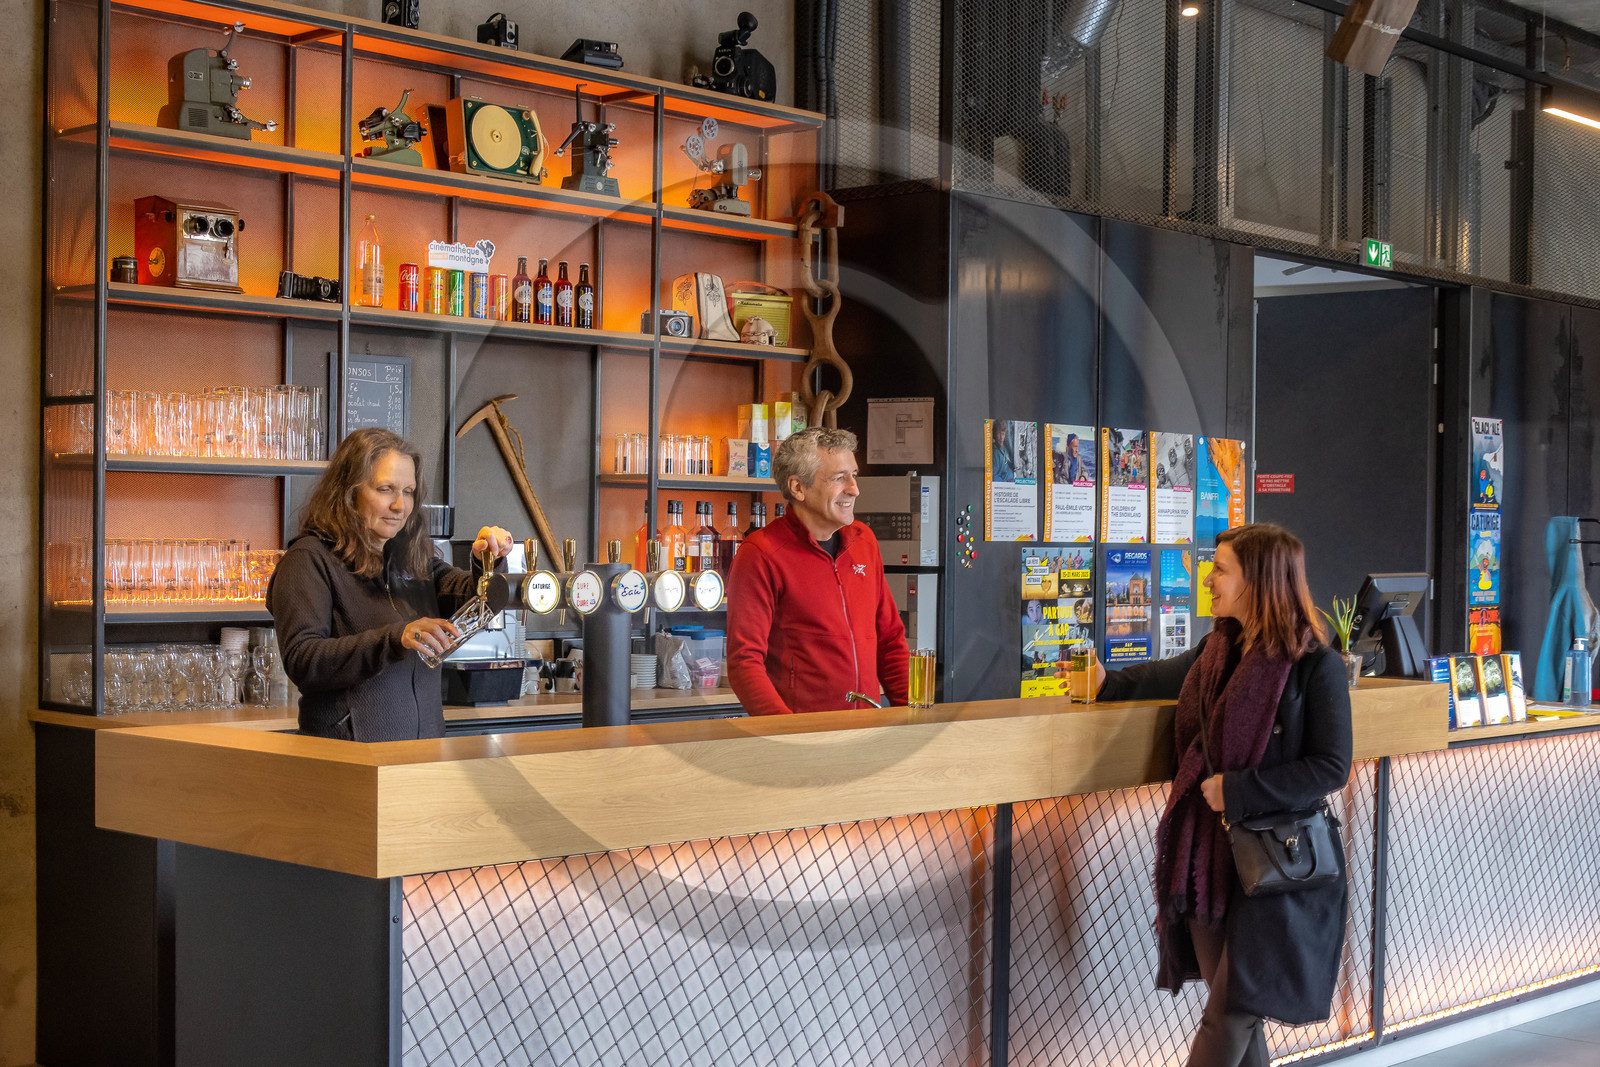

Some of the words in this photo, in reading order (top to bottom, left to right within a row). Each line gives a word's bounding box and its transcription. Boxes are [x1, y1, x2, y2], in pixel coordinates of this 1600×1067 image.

[430, 241, 480, 256] cinémathèque
[449, 254, 484, 265] montagne
[1471, 514, 1499, 530] CATURIGE
[1043, 606, 1073, 619] PARTOUT
[1114, 606, 1144, 616] MAROC
[1049, 622, 1054, 636] À
[1055, 623, 1069, 636] GAP
